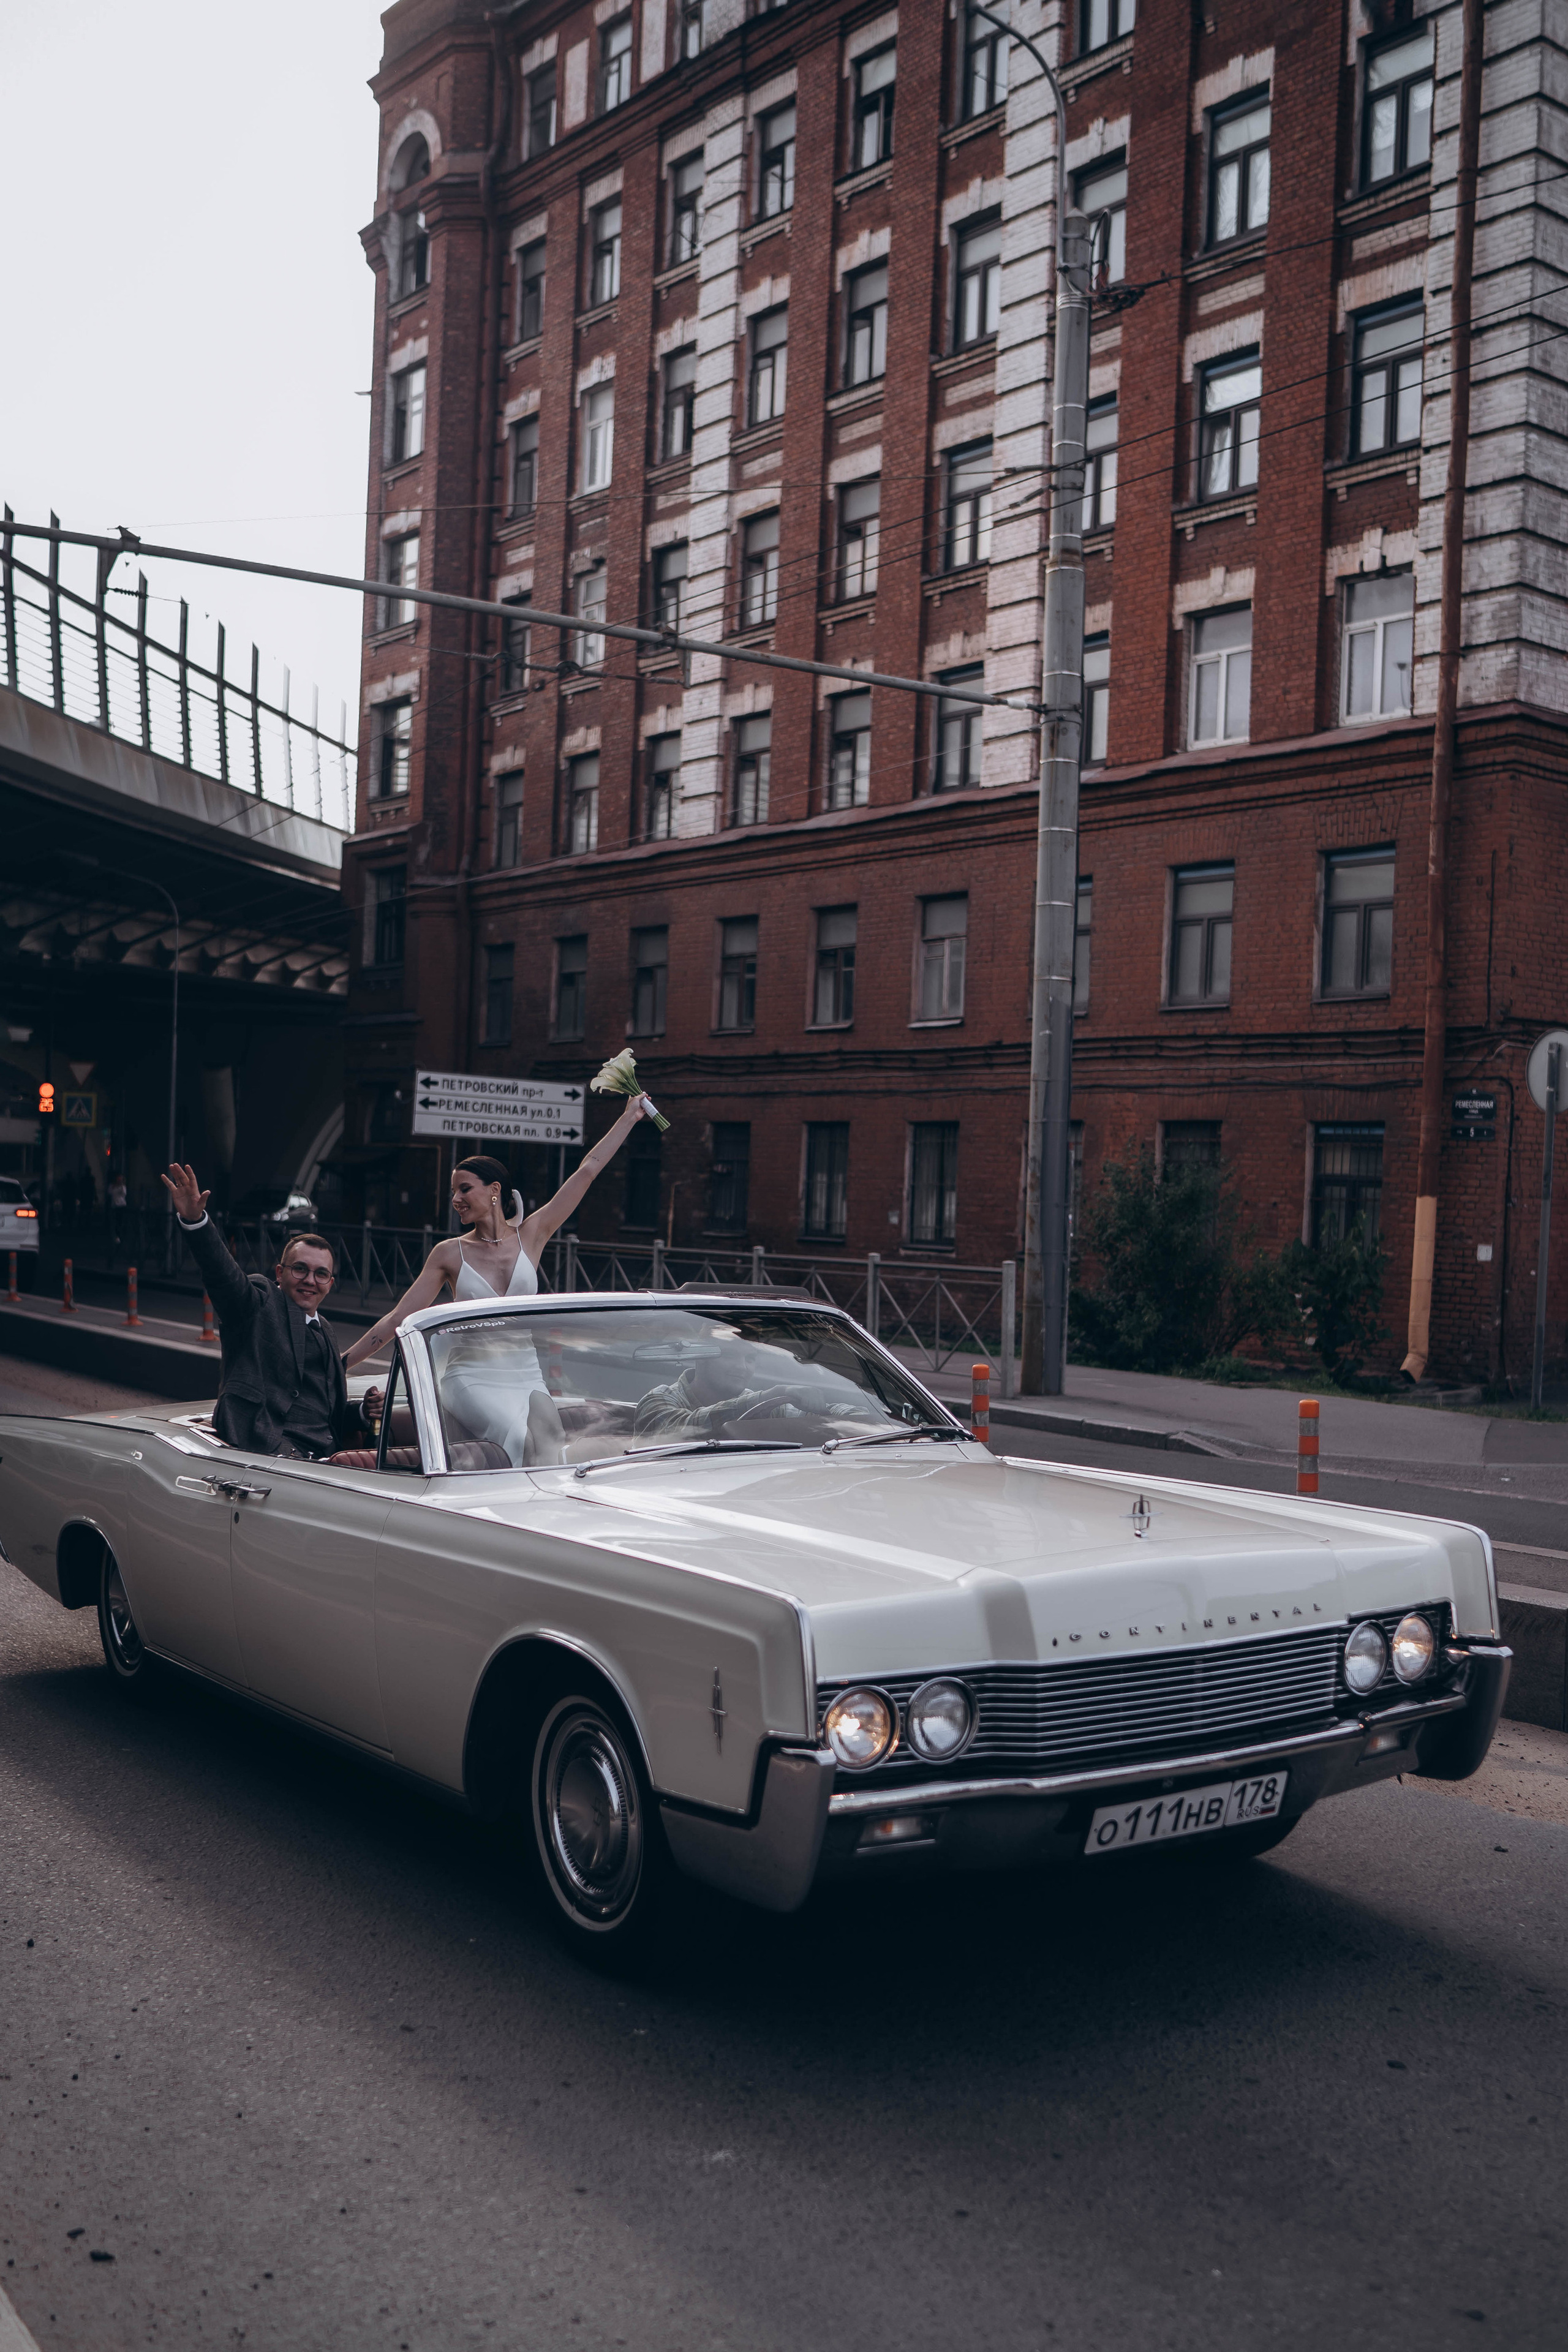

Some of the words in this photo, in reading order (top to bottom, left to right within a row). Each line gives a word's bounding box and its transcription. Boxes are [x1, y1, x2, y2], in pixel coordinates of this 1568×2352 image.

[442, 1078, 519, 1095] ПЕТРОВСКИЙ
[522, 1087, 544, 1099] пр-т
[439, 1098, 528, 1117] РЕМЕСЛЕННАЯ
[1455, 1100, 1493, 1109] РЕМЕСЛЕННАЯ
[442, 1119, 521, 1136] ПЕТРОВСКАЯ
[524, 1128, 540, 1137] пл.
[1069, 1603, 1322, 1642] CONTINENTAL
[1233, 1776, 1278, 1809] 178
[1236, 1805, 1259, 1819] RUS
